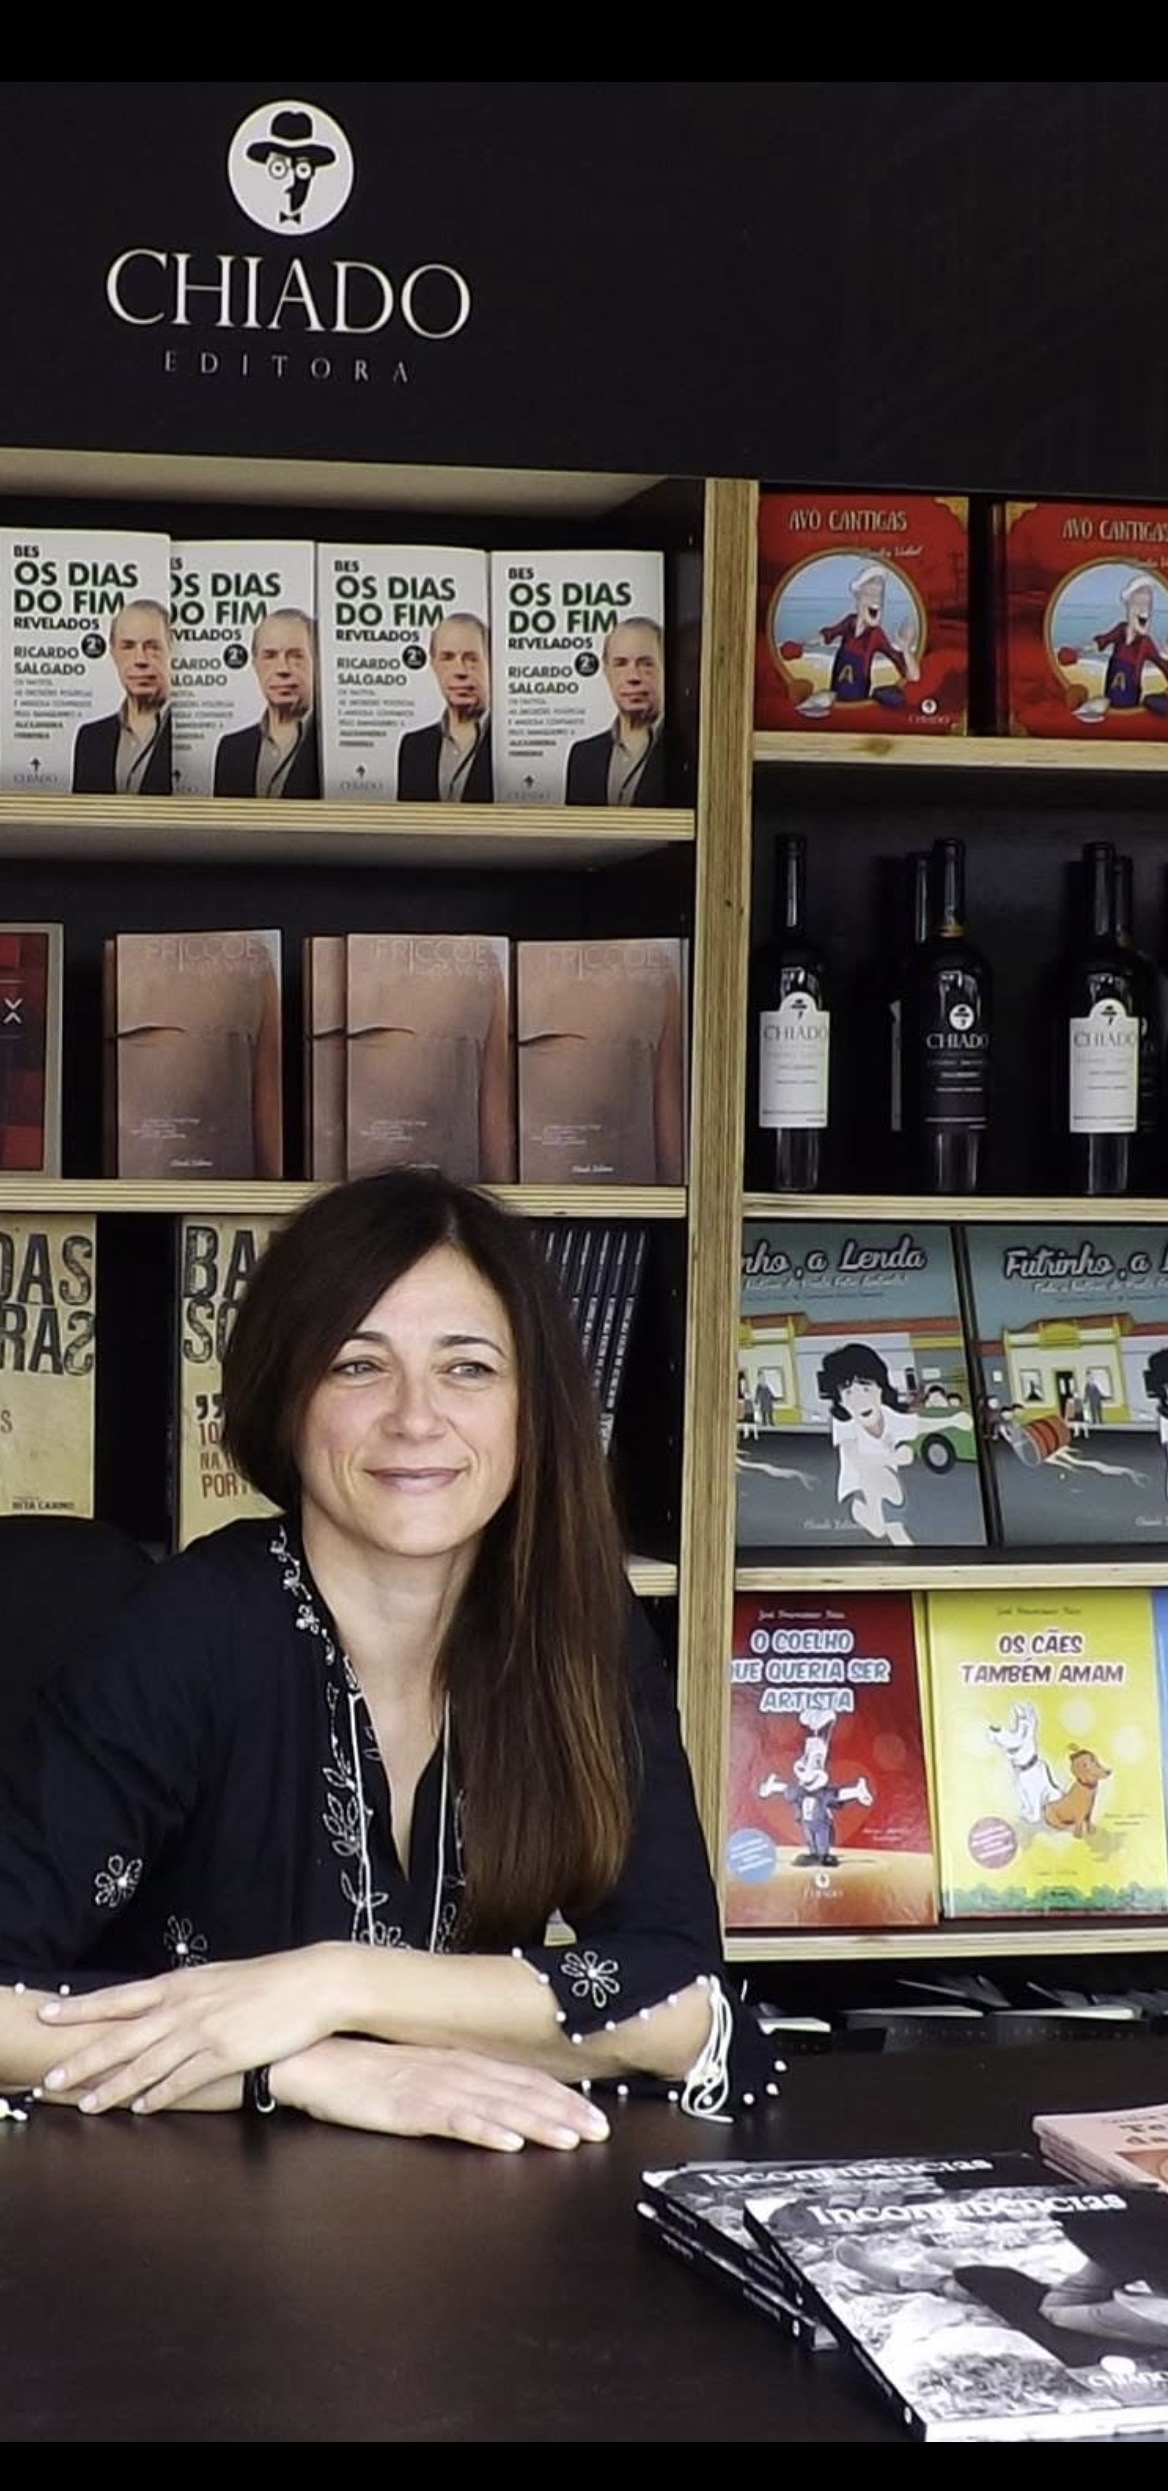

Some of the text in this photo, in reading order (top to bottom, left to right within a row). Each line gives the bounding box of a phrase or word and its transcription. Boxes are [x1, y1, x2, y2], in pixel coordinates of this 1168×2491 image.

[106, 248, 471, 338] CHIADO
[164, 350, 409, 384] EDITORA
[829, 509, 908, 532] CANTIGAS
[13, 545, 39, 558] BES
[14, 561, 138, 588] OS DIAS
[334, 560, 360, 573] BES
[508, 567, 535, 580] BES
[211, 572, 281, 598] DIAS
[336, 575, 456, 601] OS DIAS
[509, 581, 632, 607] OS DIAS
[14, 589, 125, 614] DO FIM
[13, 616, 99, 630] REVELADOS
[216, 601, 267, 625] FIM
[336, 602, 444, 627] DO FIM
[509, 609, 618, 634] DO FIM
[336, 629, 420, 642] REVELADOS
[508, 636, 593, 650] REVELADOS
[13, 646, 80, 659] RICARDO
[13, 663, 86, 676] SALGADO
[336, 658, 401, 670] RICARDO
[508, 666, 573, 678] RICARDO
[338, 673, 408, 686] SALGADO
[509, 682, 579, 694] SALGADO
[763, 1025, 828, 1040] CHIADO
[926, 1033, 989, 1049] CHIADO
[184, 1226, 260, 1300] BA
[807, 1251, 827, 1272] a
[838, 1234, 928, 1272] Lenda
[1129, 1253, 1151, 1272] a
[201, 1452, 221, 1470] NA
[752, 1630, 852, 1652] O COELHO
[999, 1628, 1083, 1654] OS CÃES
[731, 1660, 888, 1681] UE QUERIA SER
[961, 1657, 1125, 1683] TAMBÉM AMAM
[762, 1690, 852, 1712] ARTISTA
